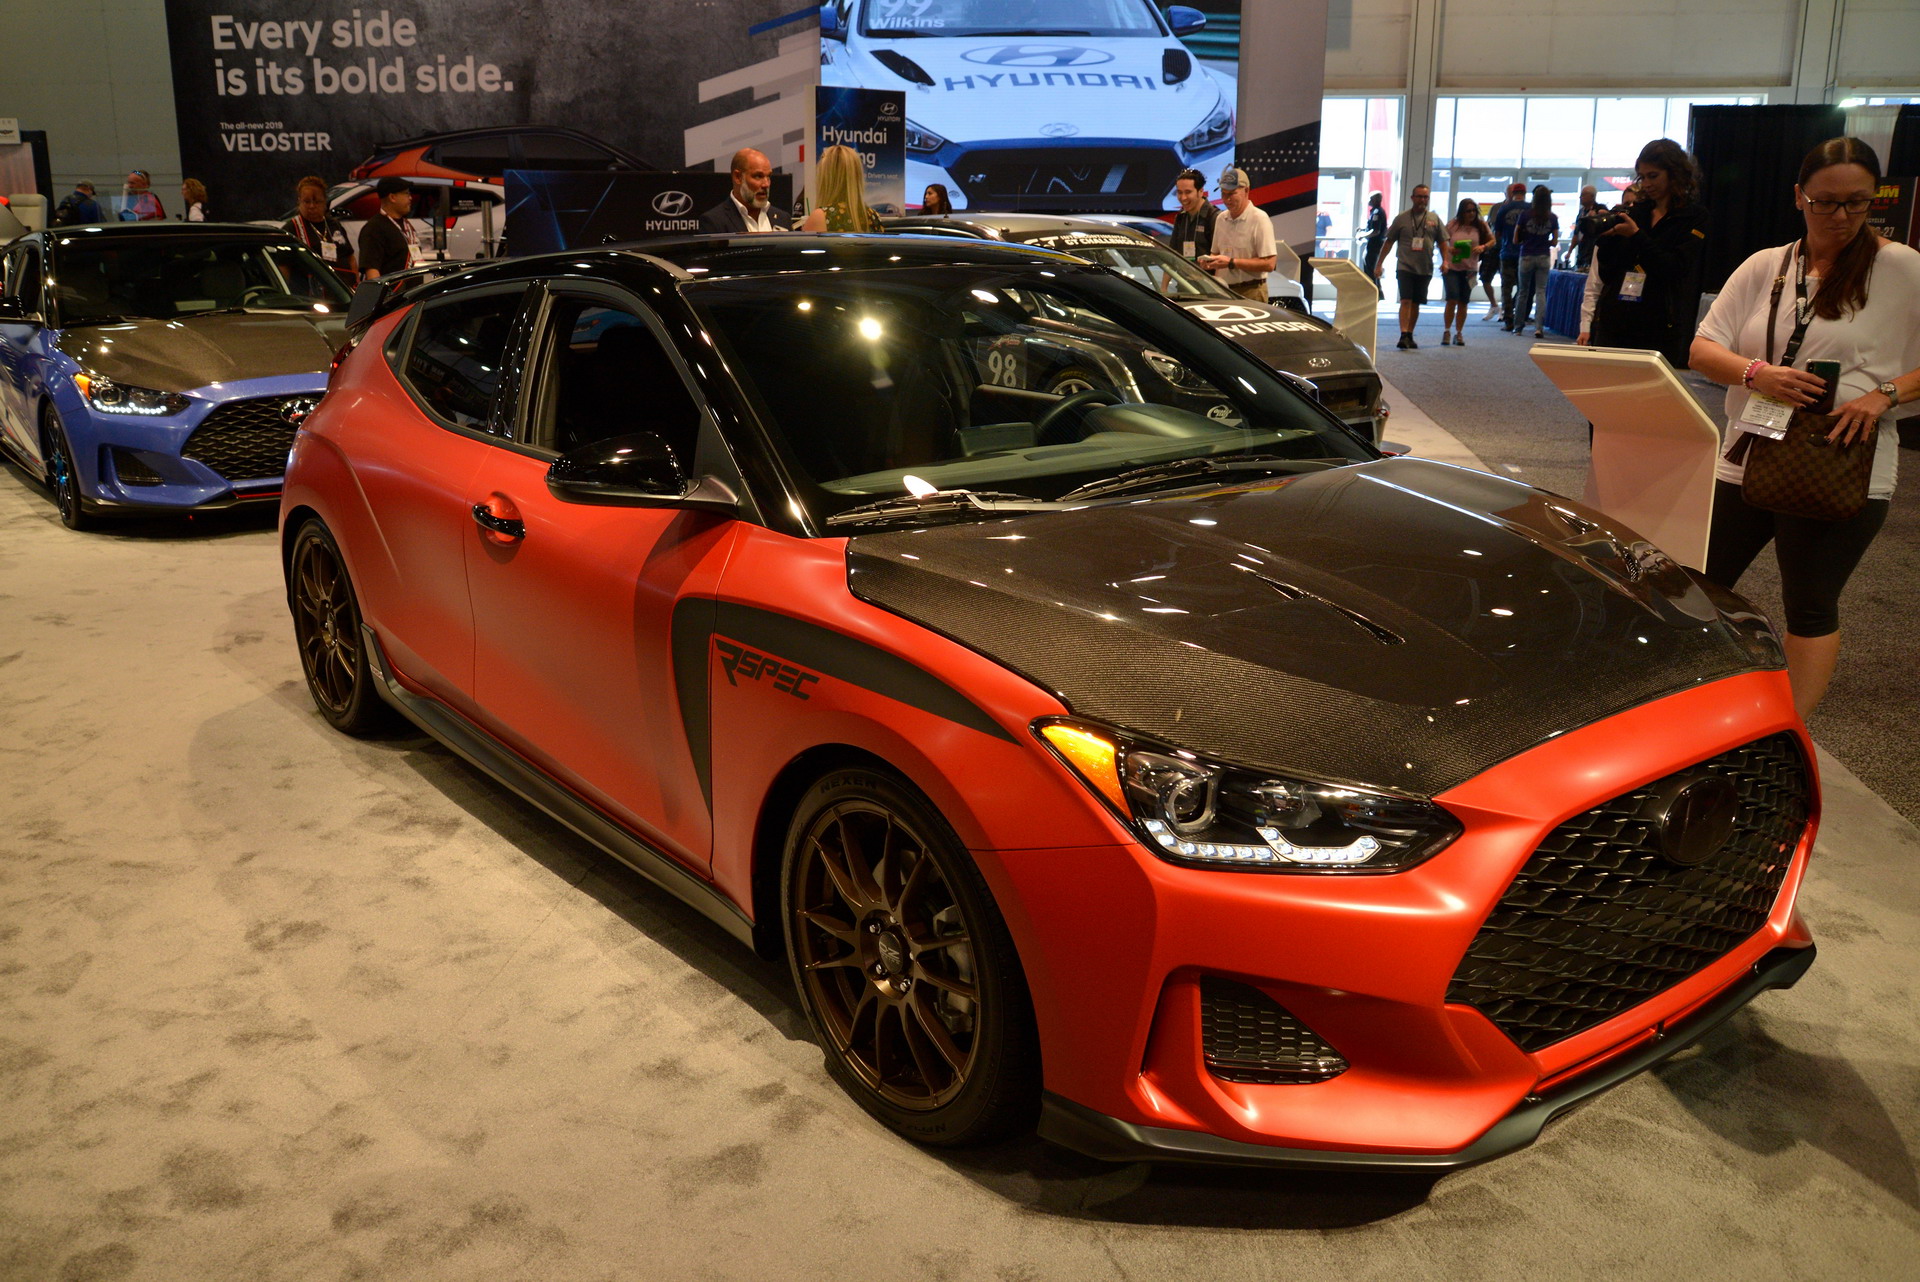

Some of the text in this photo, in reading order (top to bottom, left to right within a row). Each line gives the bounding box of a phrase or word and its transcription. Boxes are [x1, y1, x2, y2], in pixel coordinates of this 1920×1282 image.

[211, 9, 417, 56] Every side
[870, 17, 945, 29] Wilkins
[215, 54, 514, 95] is its bold side.
[944, 72, 1157, 92] HYUNDAI
[220, 121, 284, 130] The all-new 2019
[822, 125, 888, 145] Hyundai
[220, 132, 332, 152] VELOSTER
[645, 219, 700, 231] HYUNDAI
[988, 350, 1017, 388] 98
[714, 638, 820, 701] RSPEC
[820, 776, 877, 794] NEXEN
